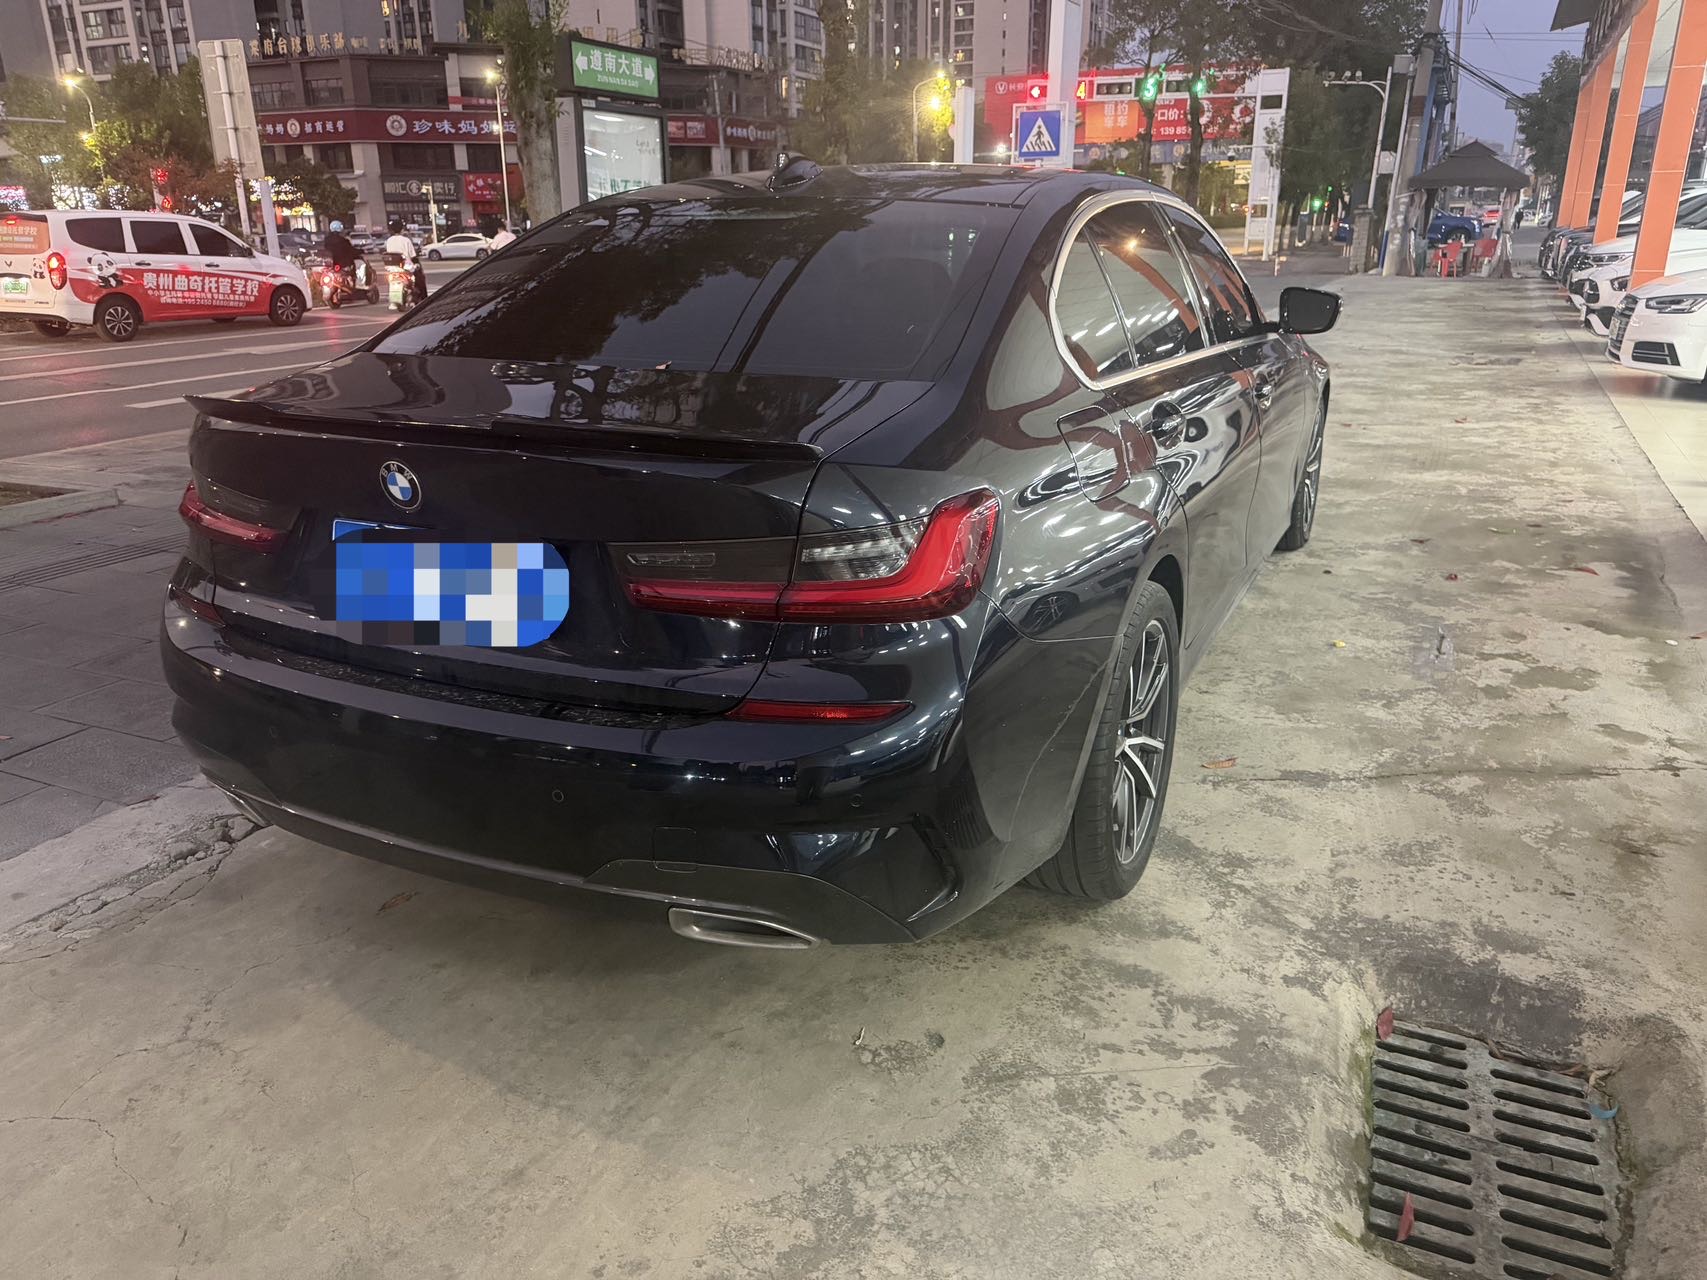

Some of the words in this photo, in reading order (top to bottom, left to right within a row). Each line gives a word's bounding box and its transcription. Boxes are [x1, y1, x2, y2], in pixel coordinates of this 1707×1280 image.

[590, 49, 643, 78] 遵南大道
[143, 271, 259, 296] 贵州曲奇托管学校
[381, 463, 413, 481] BMW
